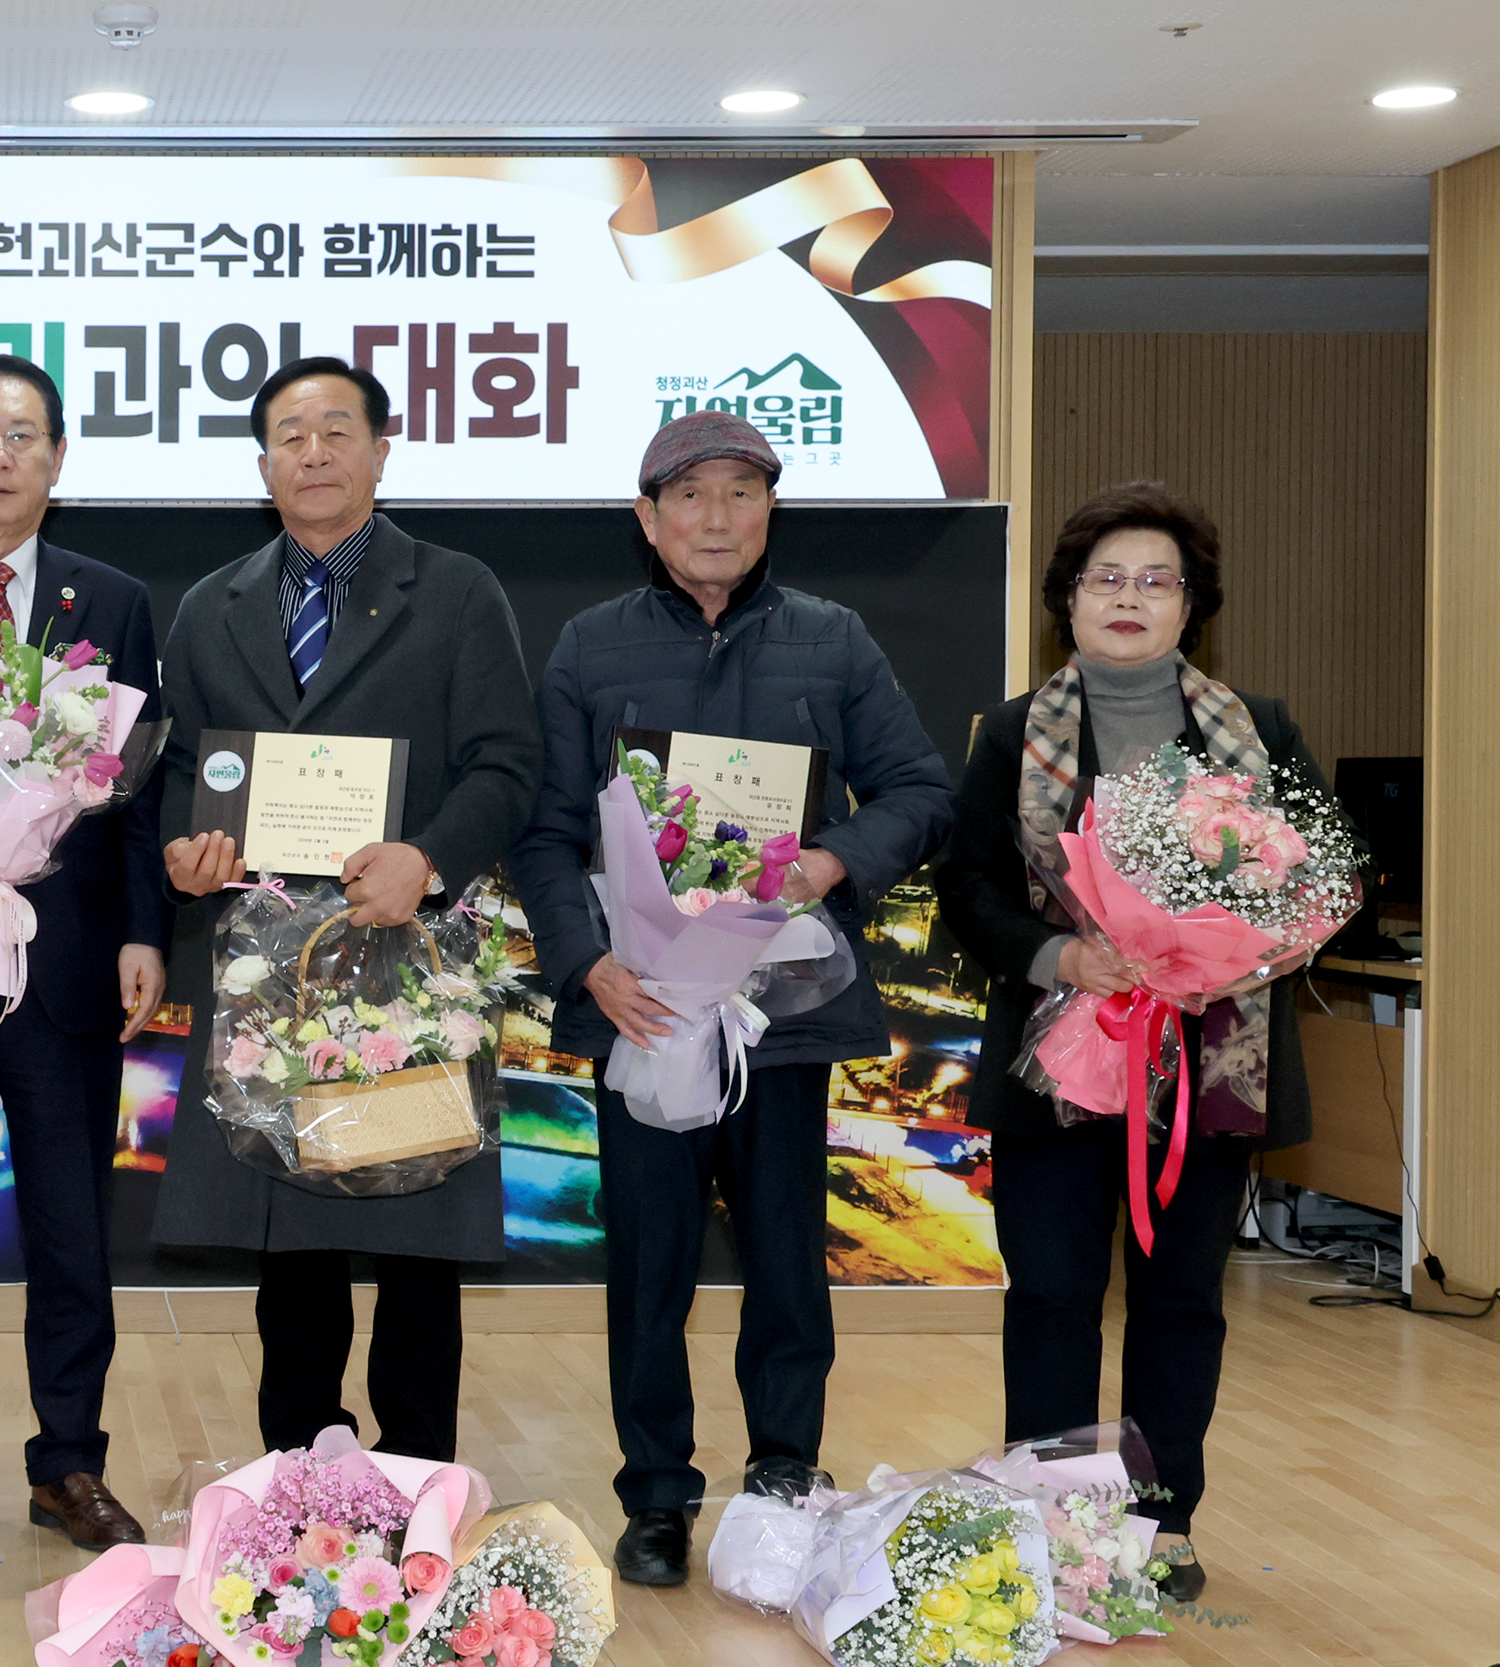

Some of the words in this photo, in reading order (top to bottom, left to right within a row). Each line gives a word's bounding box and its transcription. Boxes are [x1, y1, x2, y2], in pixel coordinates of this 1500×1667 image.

[323, 222, 536, 278] 함께하는
[353, 321, 580, 444] 대화
[655, 376, 709, 391] 청정괴산
[298, 767, 343, 779] 표창패
[715, 773, 760, 786] 표창패
